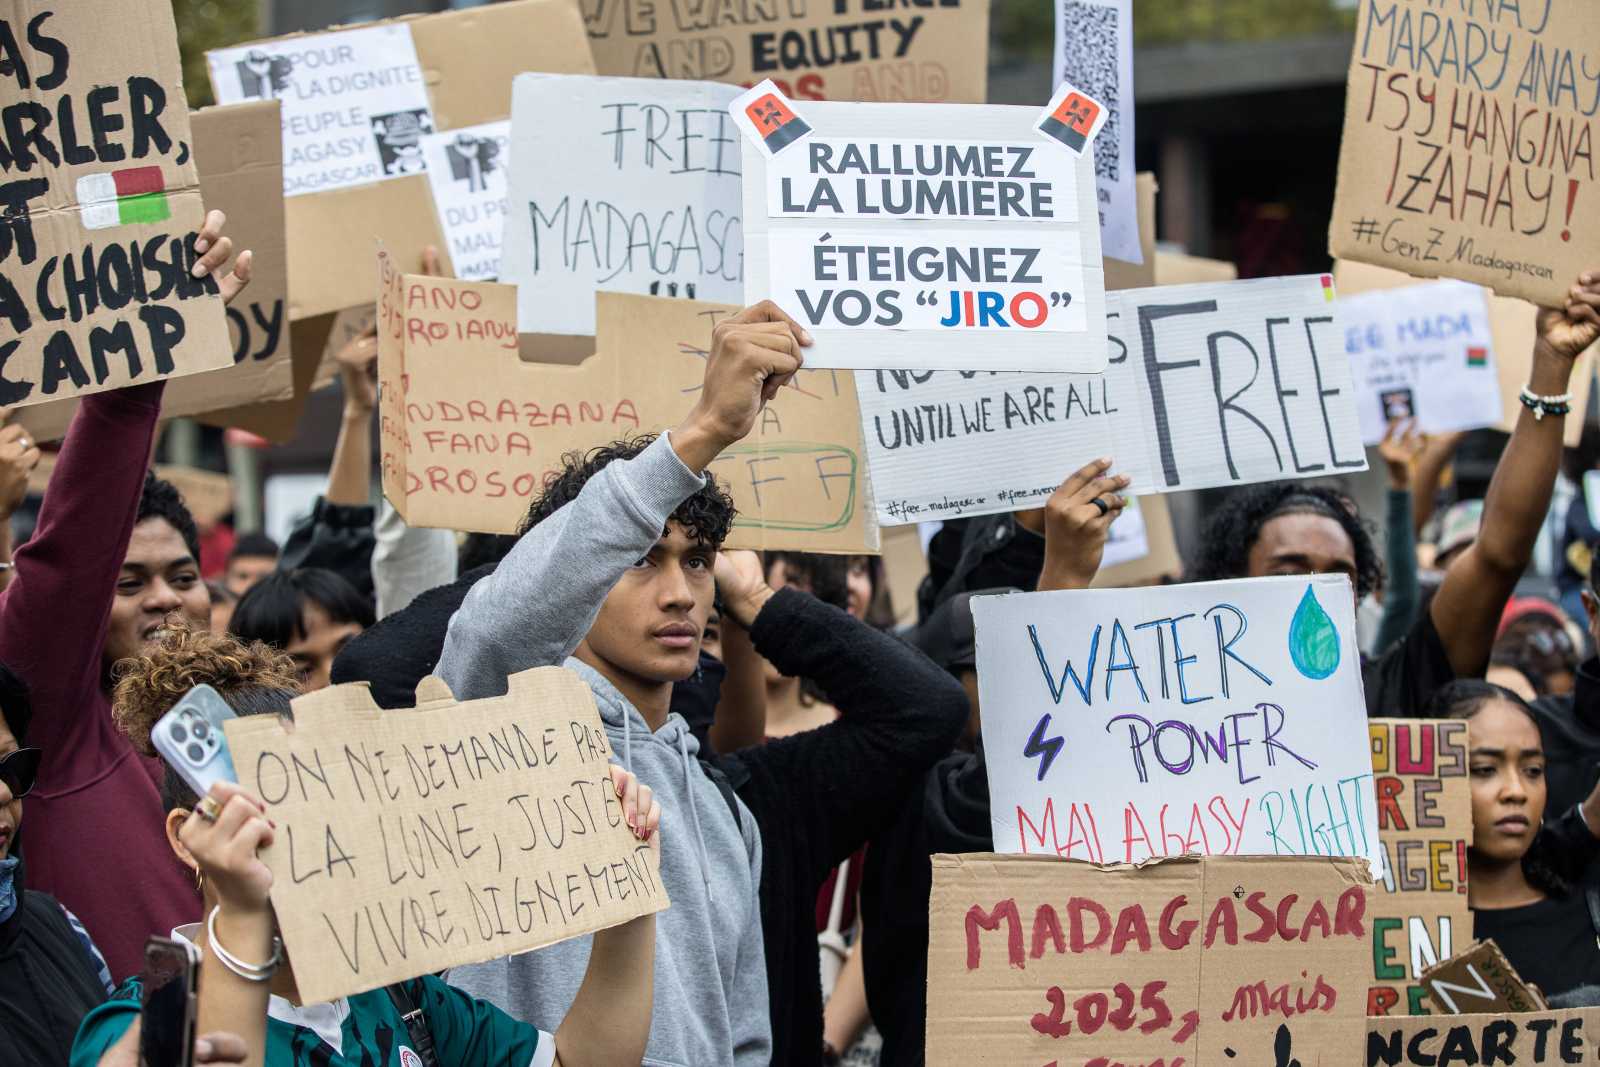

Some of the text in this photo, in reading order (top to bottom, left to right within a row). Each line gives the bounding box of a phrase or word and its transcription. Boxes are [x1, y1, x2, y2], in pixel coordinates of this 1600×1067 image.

[633, 35, 735, 80] AND
[751, 15, 924, 72] EQUITY
[1362, 0, 1511, 91] MARARY
[0, 76, 190, 173] RLER,
[281, 106, 365, 135] EUPLE
[294, 78, 326, 100] LA
[1360, 62, 1594, 181] TSY HANGINA
[601, 104, 741, 177] FREE
[809, 143, 1036, 178] RALLUMEZ
[781, 177, 844, 214] LA
[529, 196, 743, 283] MADAGASC
[814, 231, 1043, 284] ÉTEIGNEZ
[795, 289, 903, 327] VOS
[0, 304, 185, 406] CAMP
[875, 403, 956, 450] UNTIL
[960, 398, 995, 435] WE
[1004, 386, 1056, 429] ARE
[1066, 378, 1119, 419] ALL
[1138, 300, 1365, 487] FREE
[424, 431, 532, 456] FANA
[1027, 603, 1273, 706] WATER
[257, 720, 607, 805] ON NE DEMANDE PAS
[1106, 702, 1319, 784] POWER
[287, 777, 622, 884] LA LUNE, JUSTE
[1259, 773, 1375, 857] RIGHT
[465, 845, 657, 942] DIGNEMENT
[964, 884, 1367, 970] MADAGASCAR
[1373, 916, 1452, 981] EN
[1030, 970, 1337, 1044] 2025, mais
[1366, 1018, 1584, 1067] NCARTE
